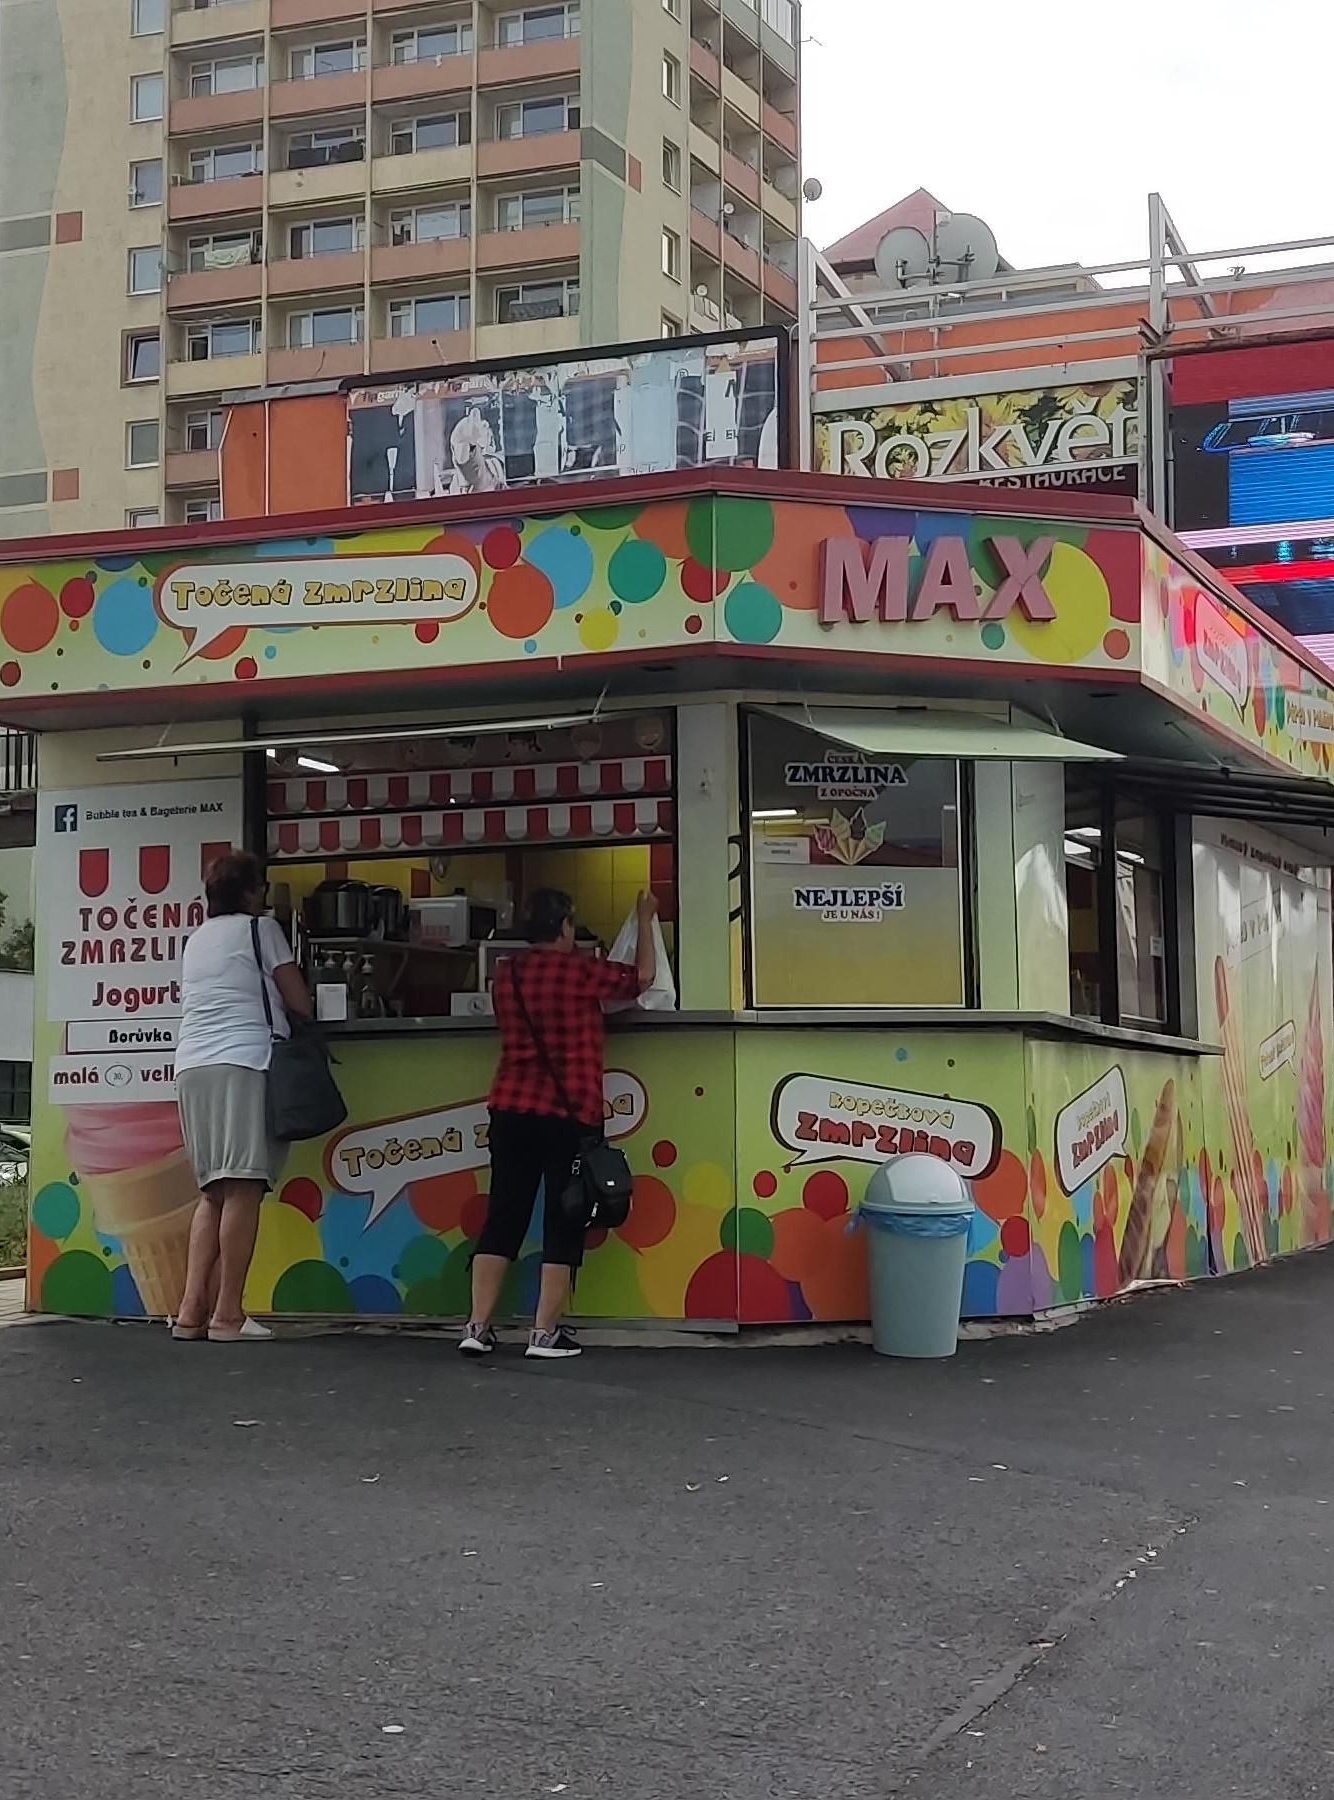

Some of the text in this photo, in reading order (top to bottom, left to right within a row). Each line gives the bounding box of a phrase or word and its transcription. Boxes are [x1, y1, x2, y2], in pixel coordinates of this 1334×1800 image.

[827, 396, 1138, 480] Rozkvět
[170, 578, 292, 611] Točená
[819, 535, 1058, 623] MAX
[786, 765, 907, 784] ZMRZLINA
[199, 802, 224, 814] MAX
[794, 884, 905, 908] NEJLEPŠÍ
[79, 896, 205, 932] TOČENÁ
[823, 910, 838, 919] JE
[840, 910, 848, 919] U
[851, 908, 875, 919] NÁS
[60, 935, 189, 966] ZMRZLI
[92, 980, 181, 1013] Jogurt
[108, 1028, 173, 1044] Borůvka
[53, 1066, 100, 1086] malá
[339, 1126, 464, 1178] Točená
